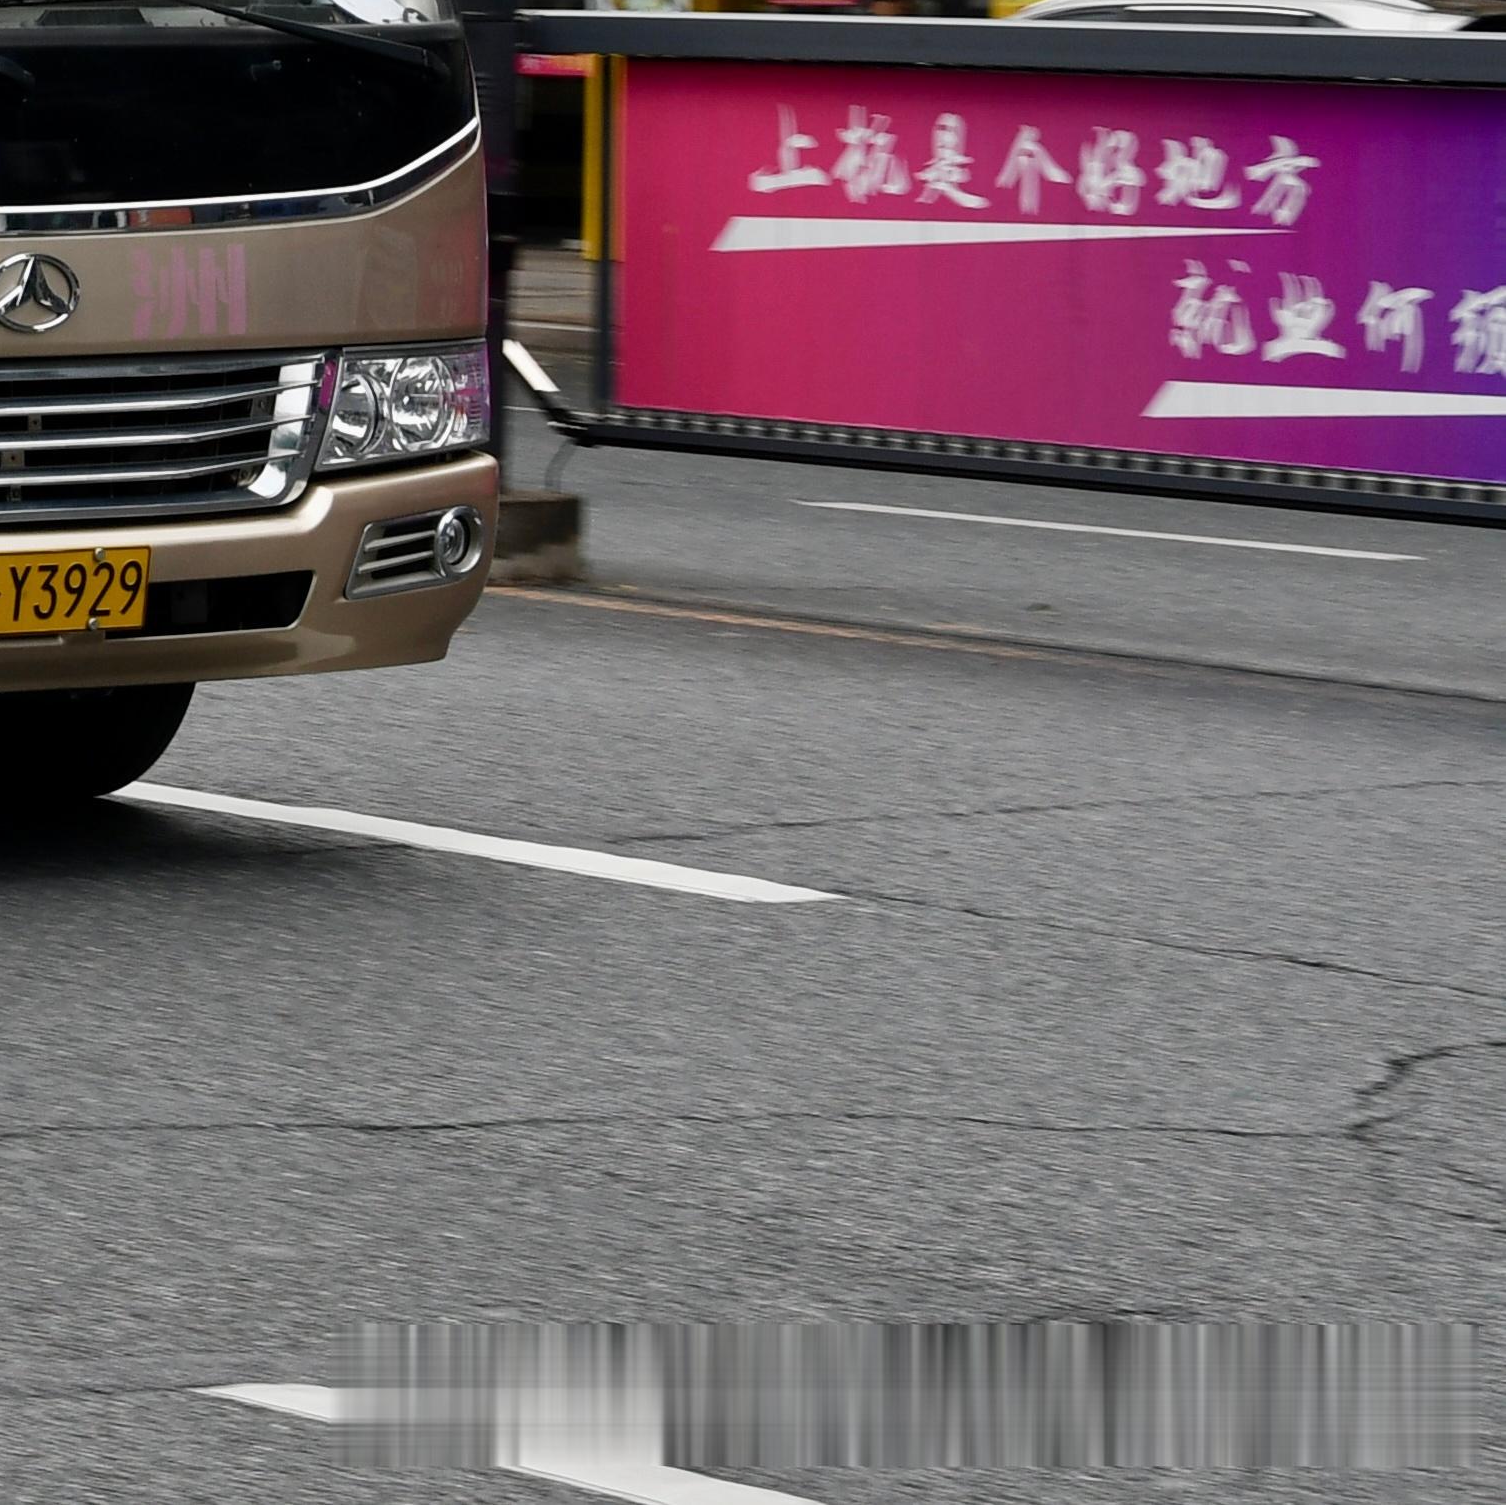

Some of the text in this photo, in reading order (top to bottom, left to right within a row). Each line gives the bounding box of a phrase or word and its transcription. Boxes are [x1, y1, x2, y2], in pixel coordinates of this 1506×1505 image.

[748, 102, 1321, 226] 上杭是个好地方
